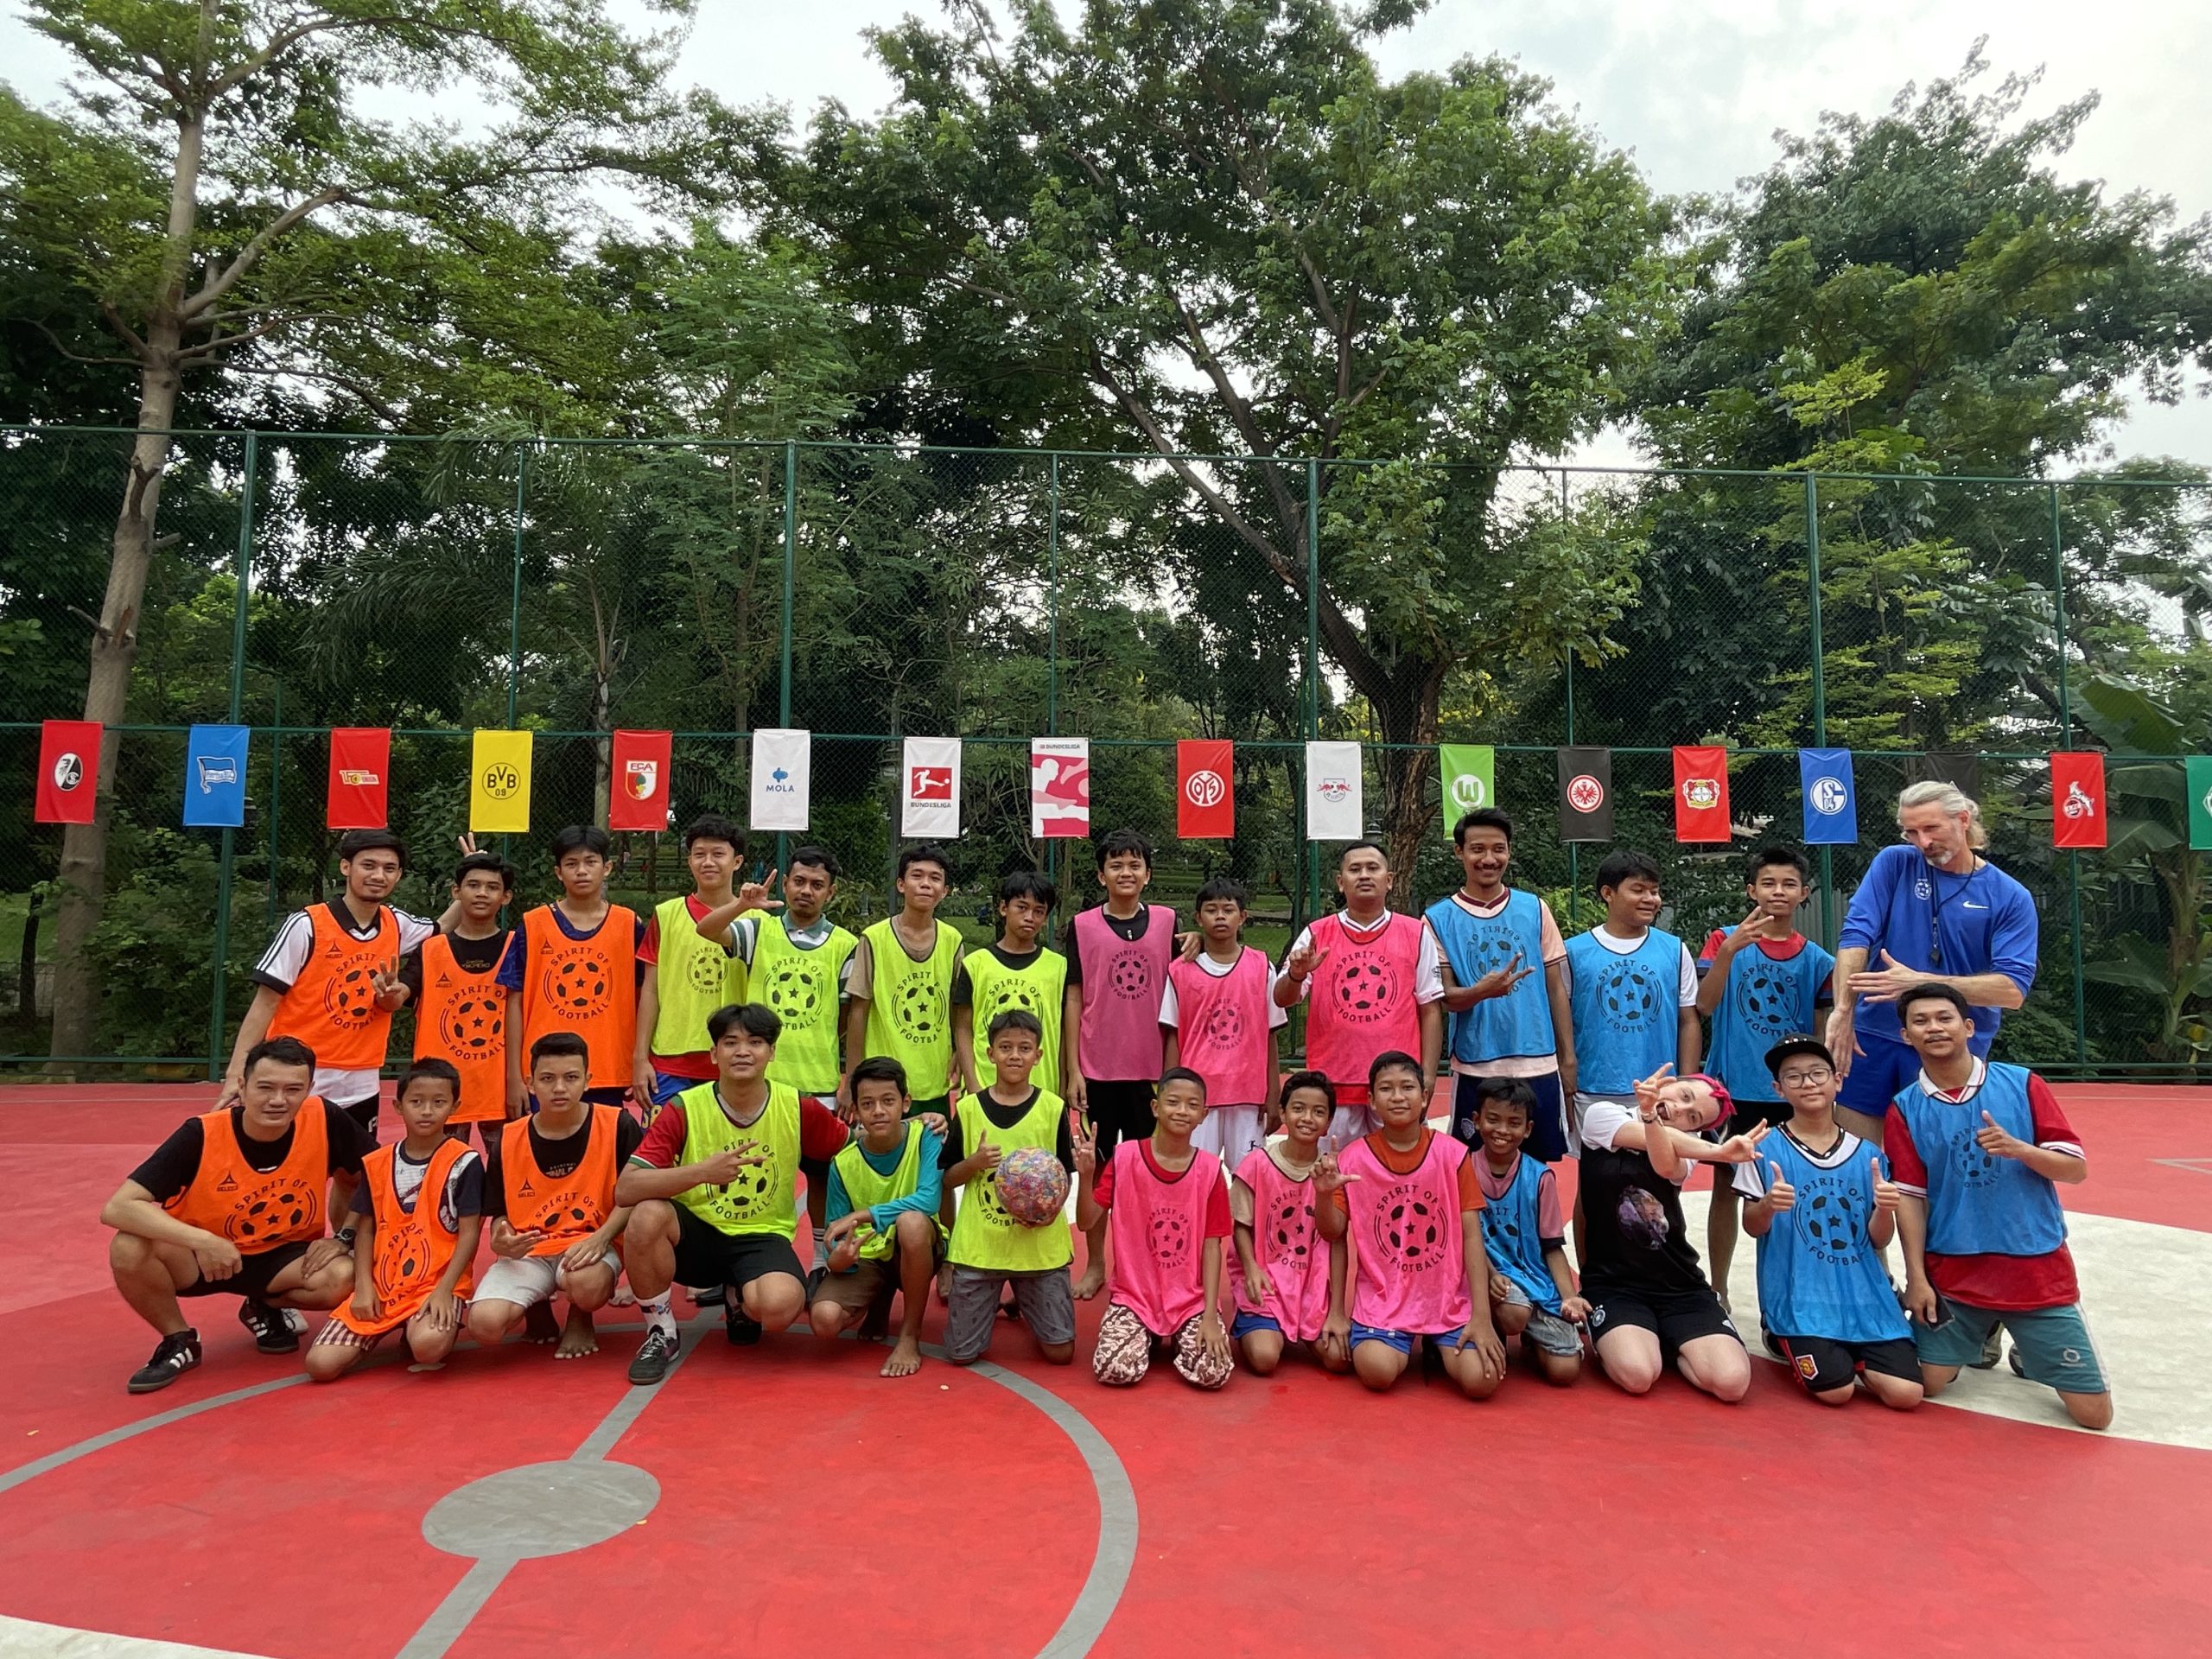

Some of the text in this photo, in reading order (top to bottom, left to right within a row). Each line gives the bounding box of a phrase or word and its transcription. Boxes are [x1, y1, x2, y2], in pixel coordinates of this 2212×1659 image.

[486, 766, 517, 788] BVB
[494, 788, 507, 797] 09
[336, 953, 377, 975] SPIRIT
[550, 947, 609, 966] SPIRIT OF
[1111, 950, 1148, 963] SPIRIT OF
[1336, 951, 1391, 969] SPIRIT OF
[772, 957, 823, 979] SPIRIT OF
[1599, 959, 1656, 982] SPIRIT OF
[1742, 963, 1782, 980] SPIRIT
[897, 971, 931, 992] SPIRIT
[988, 978, 1041, 999] SPIRIT OF
[448, 985, 490, 1006] SPIRIT
[552, 1002, 609, 1020] FOOTBALL
[1338, 1007, 1392, 1023] FOOTBALL
[448, 1040, 506, 1061] FOOTBALL
[761, 1144, 775, 1159] OF
[234, 1178, 308, 1211] SPIRIT OF
[1376, 1184, 1439, 1212] SPIRIT OF
[1798, 1177, 1866, 1202] SPIRIT OF
[535, 1192, 595, 1219] SPIRIT OF
[709, 1199, 771, 1220] FOOTBALL
